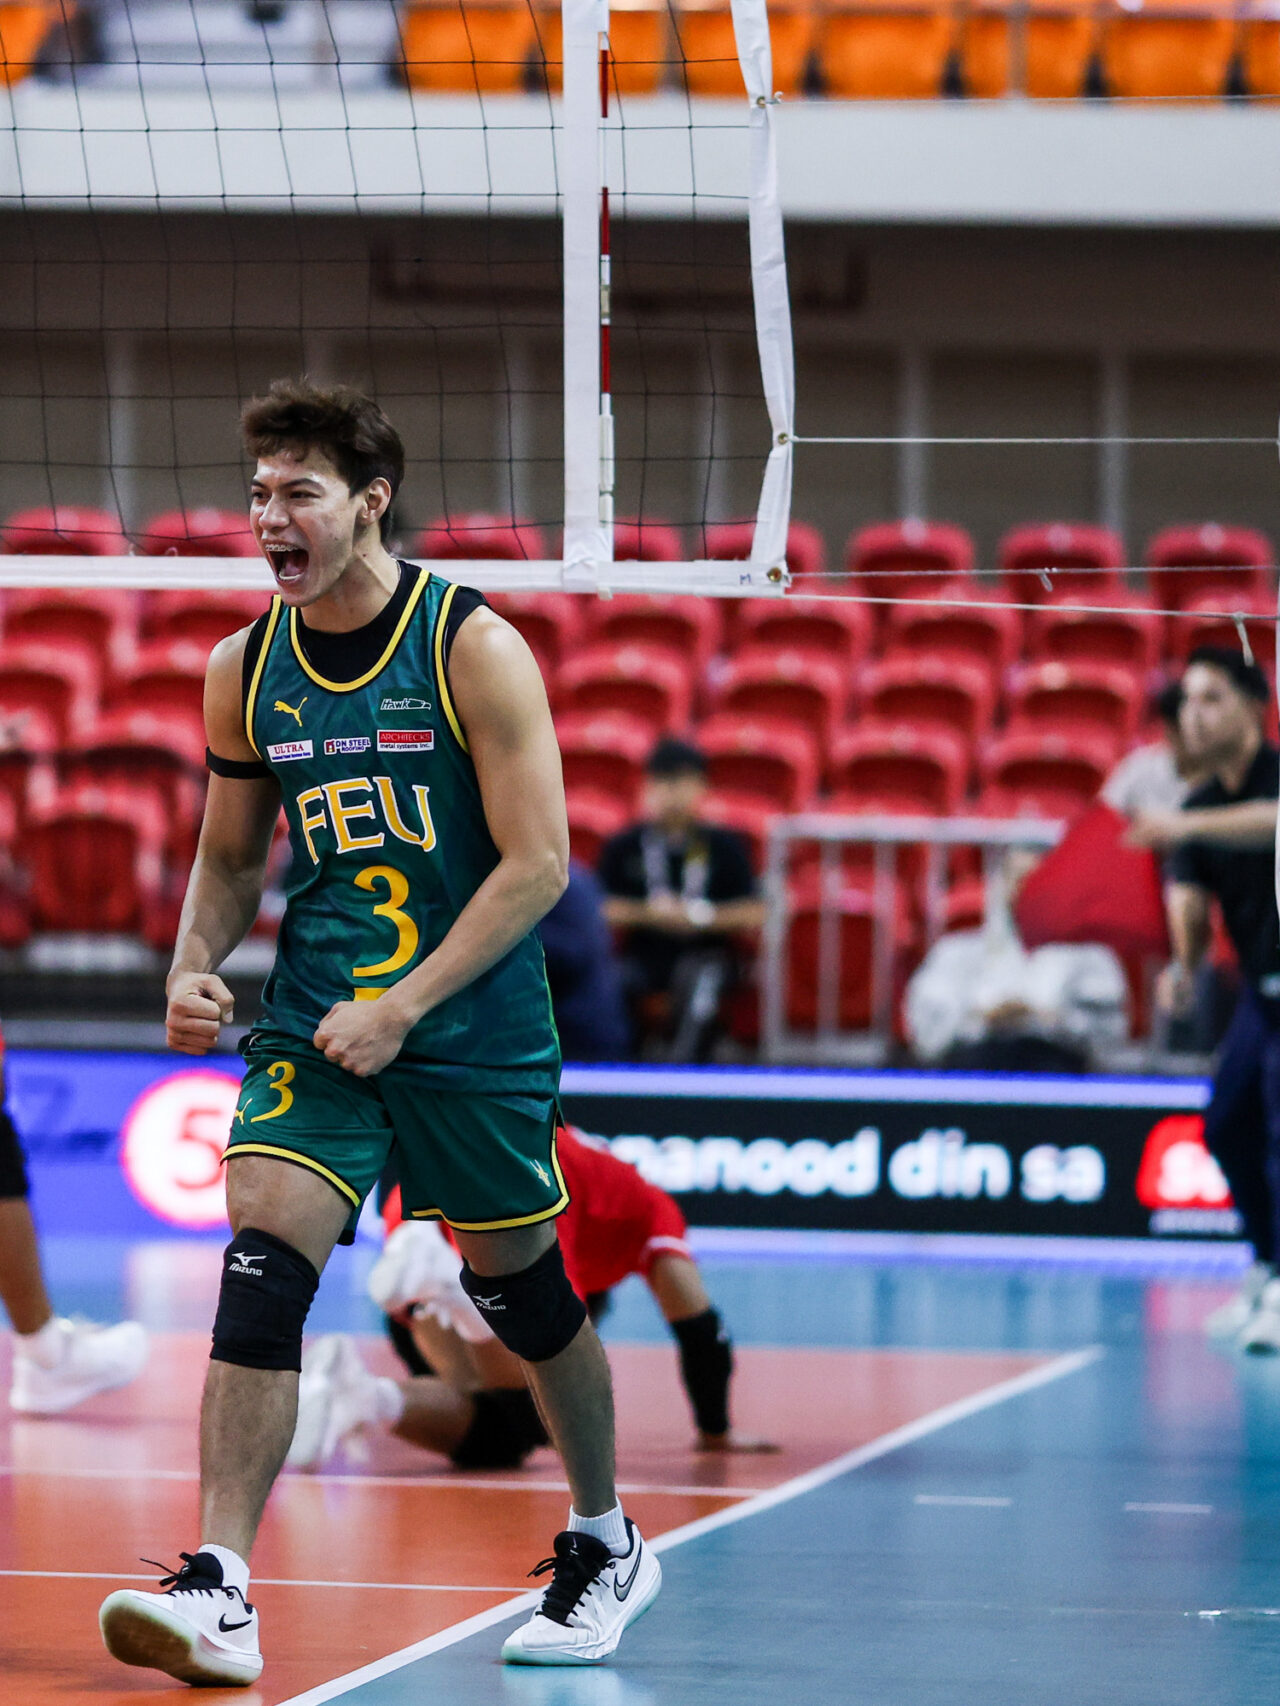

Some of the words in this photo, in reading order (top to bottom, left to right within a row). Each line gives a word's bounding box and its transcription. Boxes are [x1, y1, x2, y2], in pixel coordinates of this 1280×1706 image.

[274, 743, 305, 754] ULTRA
[296, 776, 437, 865] FEU
[353, 865, 419, 1001] 3
[251, 1061, 297, 1123] 3
[888, 1127, 1012, 1200] din
[1020, 1143, 1106, 1204] sa
